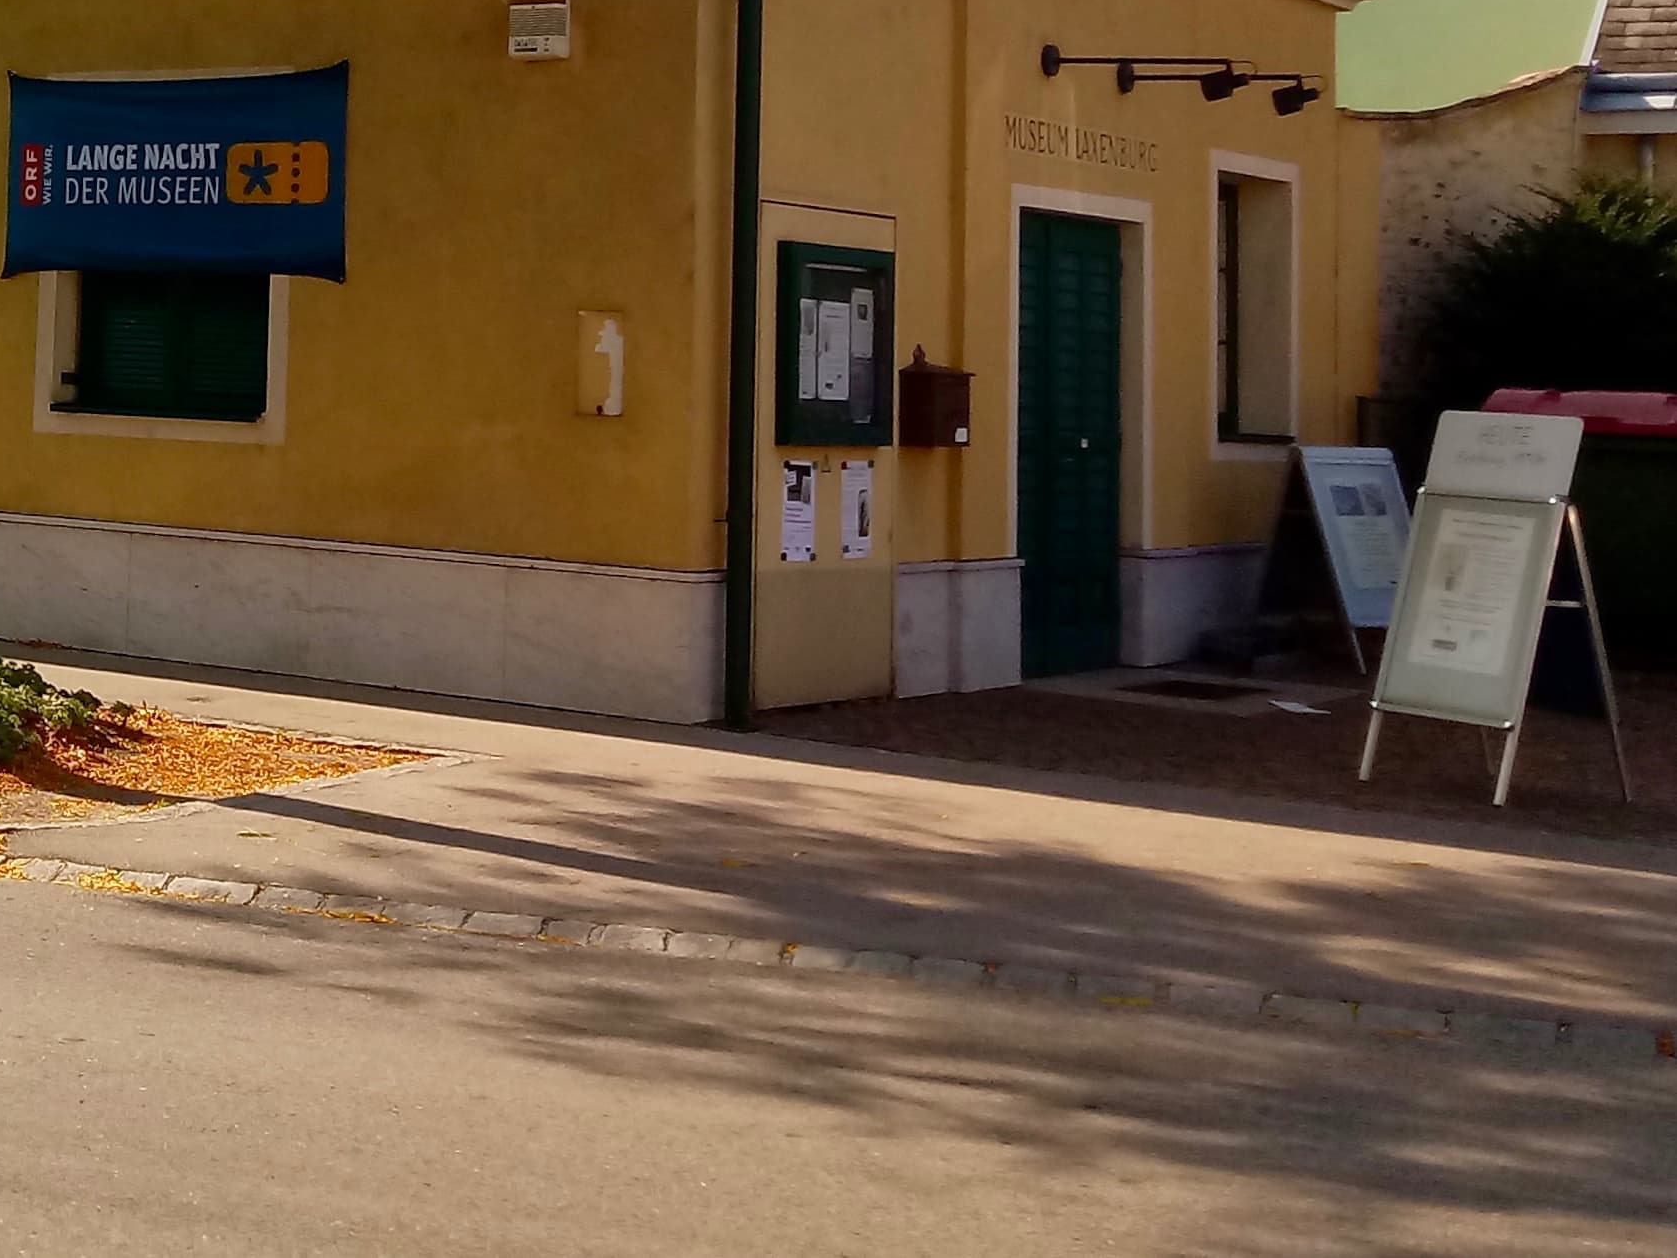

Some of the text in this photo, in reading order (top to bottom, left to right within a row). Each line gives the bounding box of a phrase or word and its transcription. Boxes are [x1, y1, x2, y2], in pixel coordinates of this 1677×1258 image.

[66, 143, 220, 171] LANGE NACHT
[1005, 115, 1159, 172] MUSEUM LAXENBURG
[25, 149, 39, 201] ORF
[42, 175, 52, 205] WIE
[65, 176, 219, 205] DER MUSEEN
